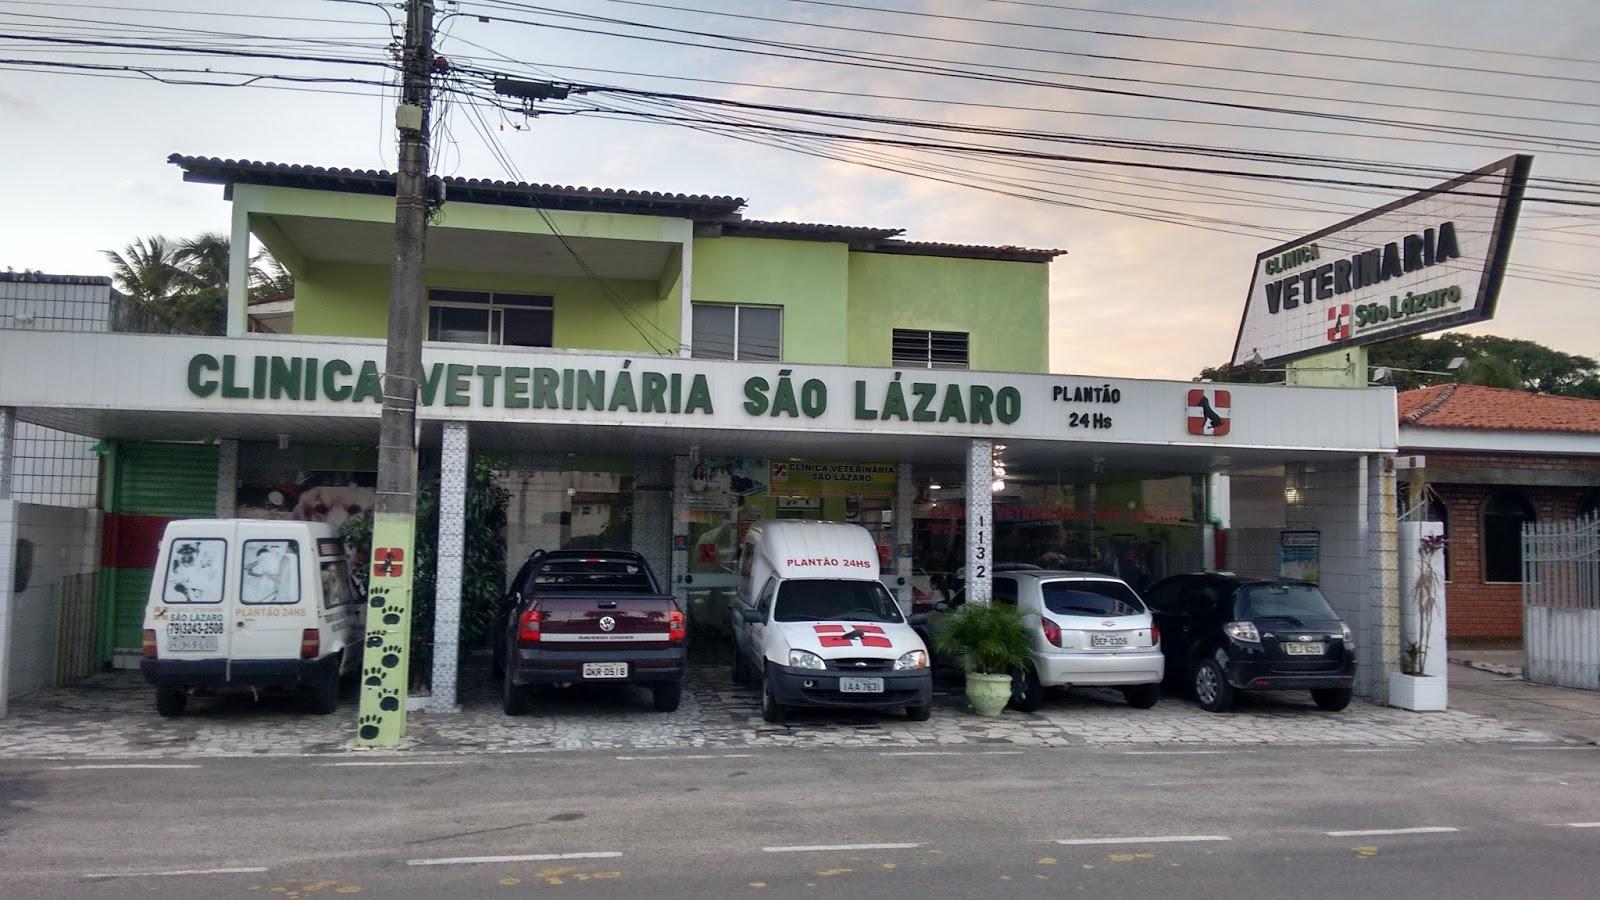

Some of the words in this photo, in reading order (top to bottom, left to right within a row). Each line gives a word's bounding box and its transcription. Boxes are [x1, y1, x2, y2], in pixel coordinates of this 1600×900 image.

[1265, 242, 1320, 275] CLINICA
[1355, 302, 1389, 327] São
[1389, 285, 1462, 319] Lázaro
[187, 353, 384, 403] CLINICA
[420, 359, 714, 414] VETERINÁRIA
[743, 369, 828, 419] SÃO
[854, 371, 1022, 425] LÁZARO
[1053, 384, 1121, 404] PLANTÃO
[787, 558, 839, 567] PLANTÃO
[843, 559, 871, 569] 24HS
